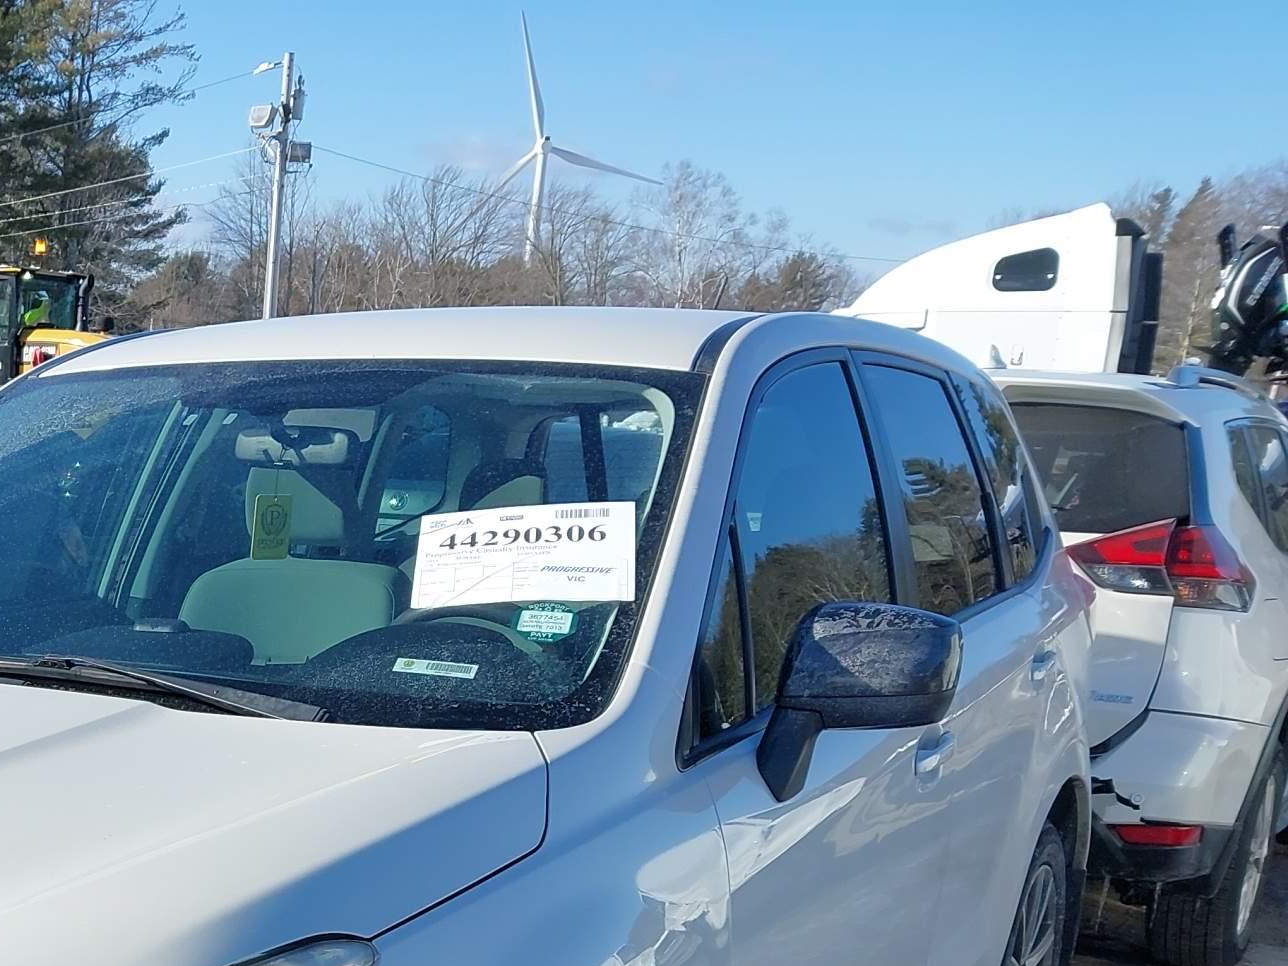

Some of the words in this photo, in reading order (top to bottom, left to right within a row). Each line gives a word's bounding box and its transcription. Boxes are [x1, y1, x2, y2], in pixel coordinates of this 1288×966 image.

[439, 524, 608, 550] 44290306
[540, 565, 615, 574] PROGRESSIVE
[527, 602, 571, 612] ROCKPORT
